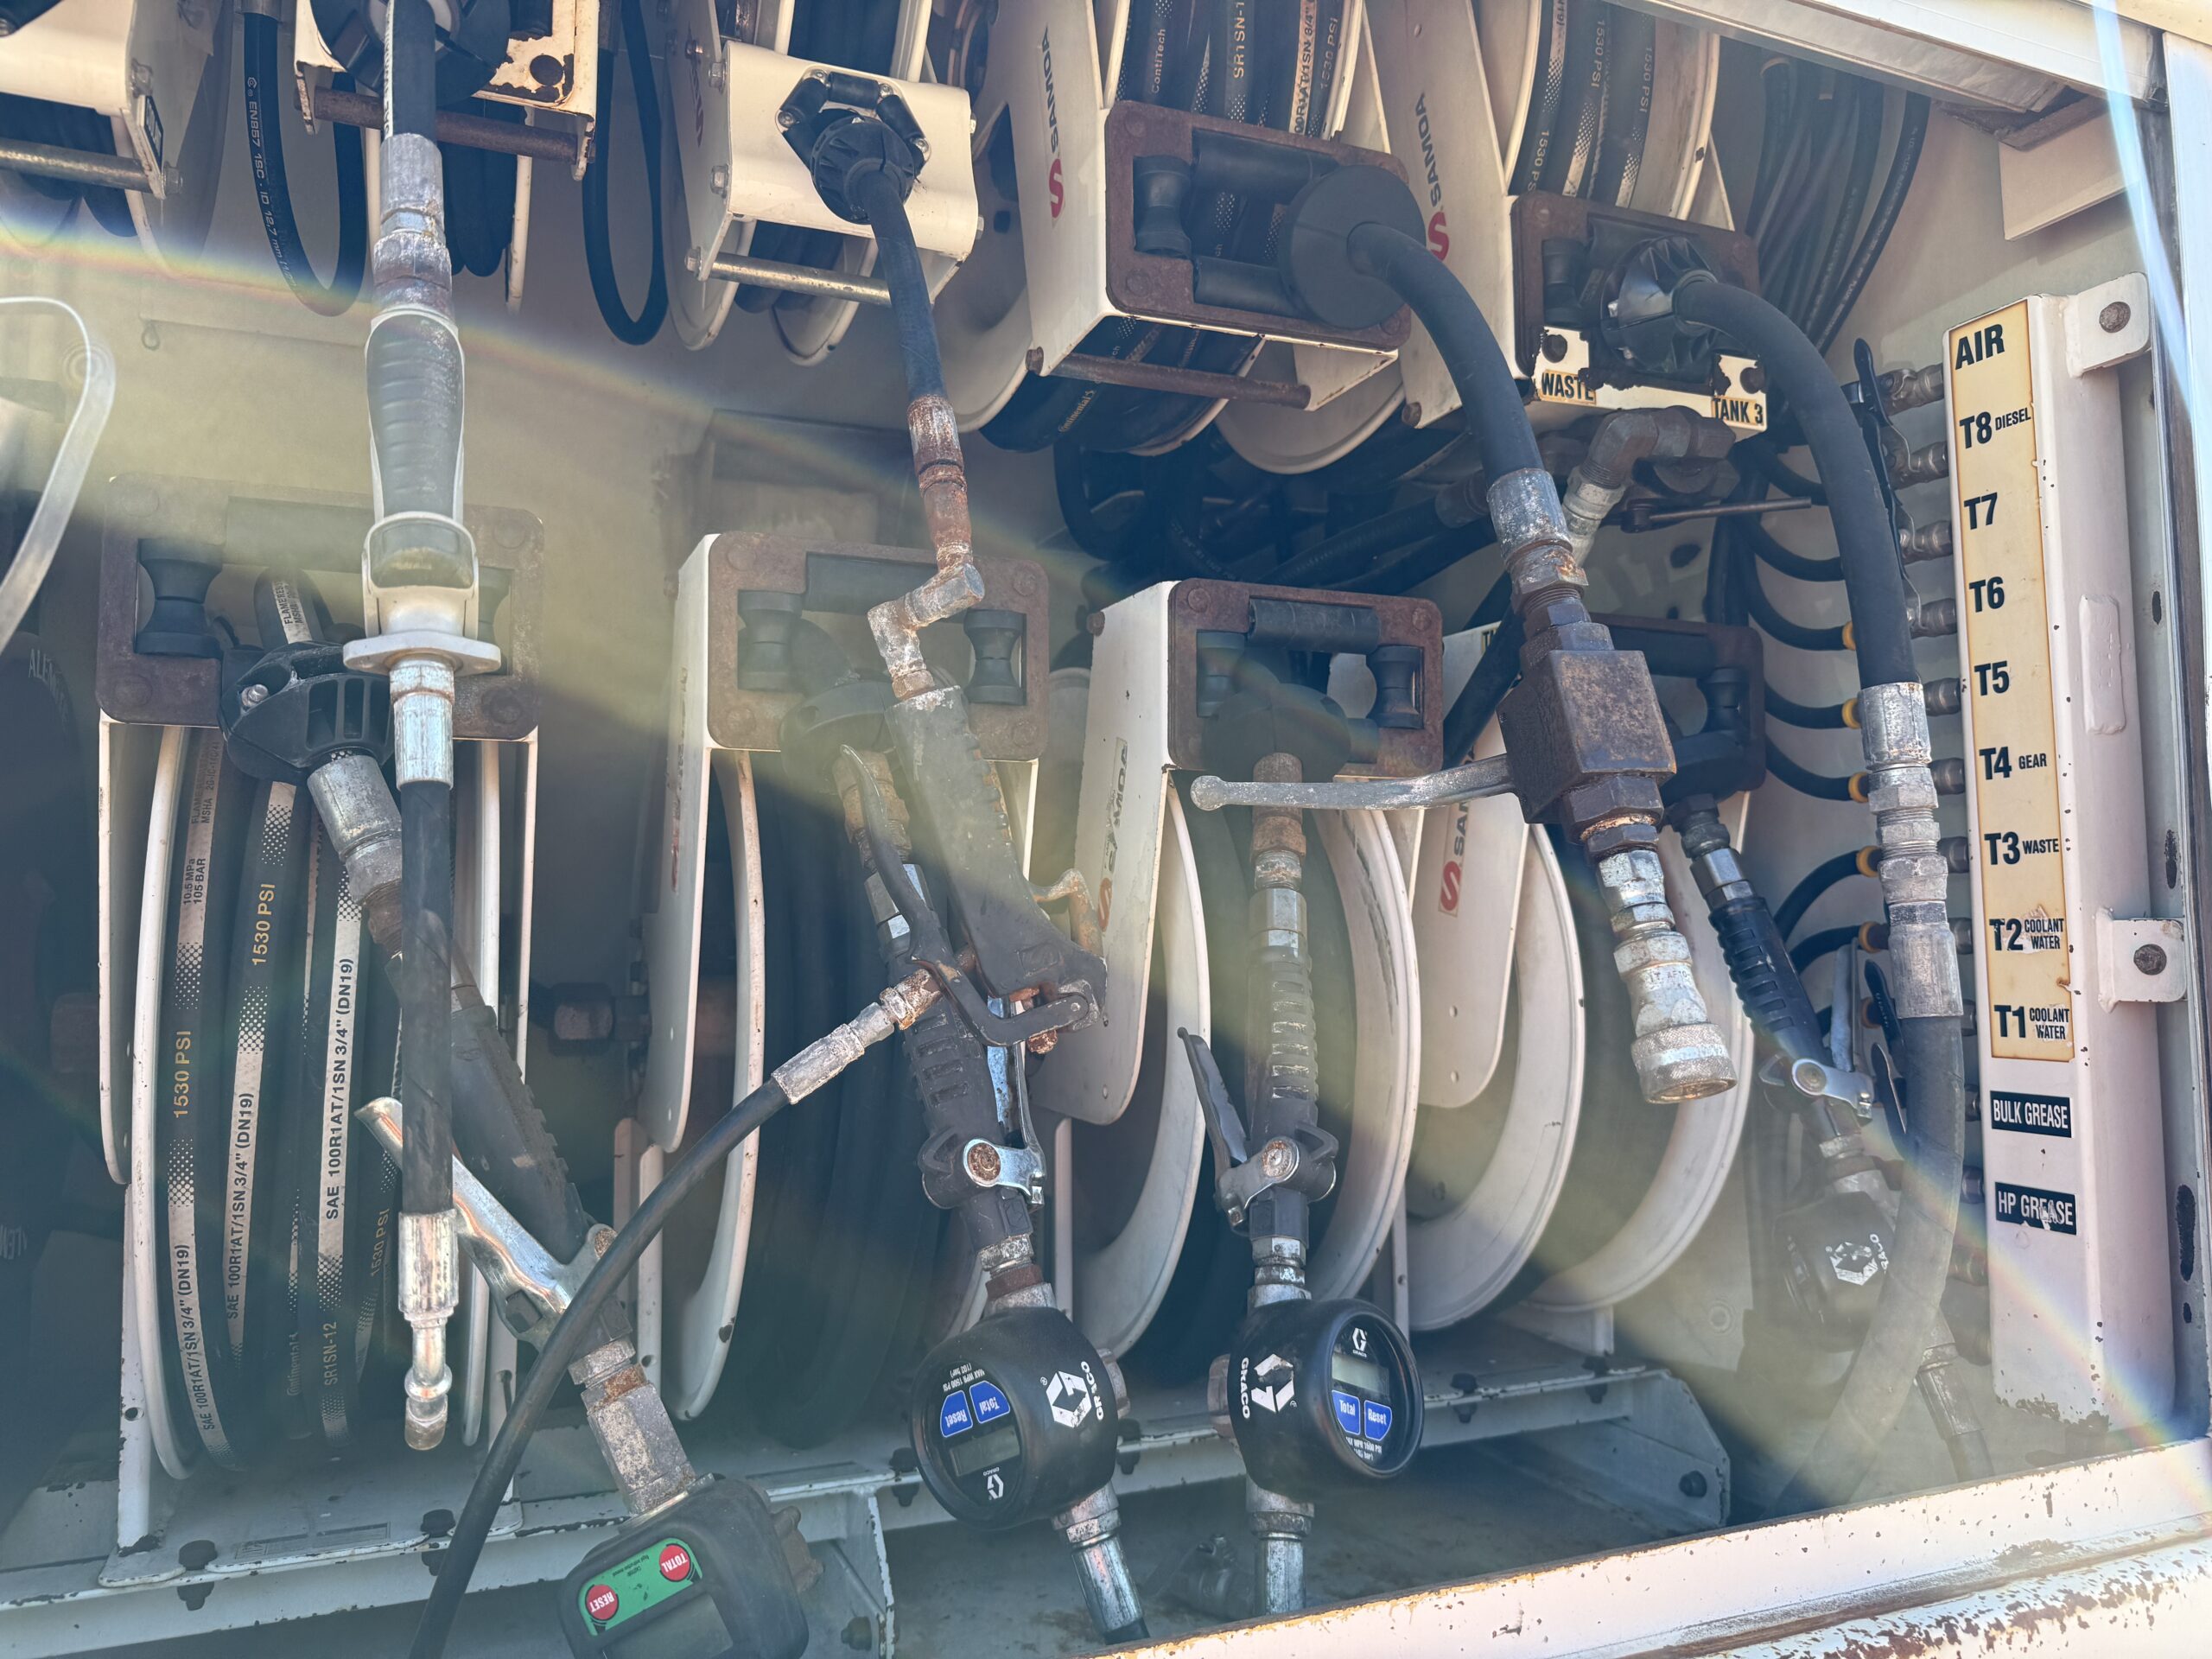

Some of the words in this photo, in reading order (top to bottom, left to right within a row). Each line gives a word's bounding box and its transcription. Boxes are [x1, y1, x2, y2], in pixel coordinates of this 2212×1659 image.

[1321, 52, 1334, 90] 1530
[1329, 17, 1339, 47] PSI
[1595, 20, 1605, 56] 1530
[1151, 29, 1166, 93] ContiTech
[1591, 60, 1603, 87] PSI
[1643, 48, 1652, 81] 1530
[1042, 27, 1058, 154] SAMOA
[1639, 86, 1650, 112] PSI
[1415, 92, 1441, 207] SAMOA
[1534, 130, 1549, 167] 1530
[1955, 324, 2005, 370] AIR
[1541, 372, 1594, 402] WASTE
[1713, 397, 1751, 423] TANK
[1754, 404, 1764, 424] 3
[1960, 411, 1993, 449] T8
[1995, 407, 2031, 431] DIESEL
[1964, 492, 1998, 530] T7
[1968, 576, 2005, 613] T6
[1974, 660, 2010, 696] T5
[1979, 747, 2012, 780] T4
[2018, 753, 2047, 769] GEAR
[200, 798, 213, 823] MSHA
[1984, 831, 2020, 865] T3
[2023, 838, 2059, 854] WASTE
[257, 884, 275, 916] PSI
[251, 920, 270, 966] 1530
[1989, 918, 2023, 951] T2
[2024, 918, 2064, 933] COOLANT
[2031, 935, 2060, 950] WATER
[336, 958, 354, 1015] (DN19)
[334, 1019, 347, 1055] 3/4"
[1993, 1004, 2026, 1039] T1
[2029, 1007, 2069, 1023] COOLANT
[2036, 1024, 2066, 1039] WATER
[175, 1031, 191, 1065] PSI
[174, 1071, 189, 1118] 1530
[235, 1093, 255, 1149] (DN19)
[329, 1059, 346, 1176] 100R1AT/1SN
[1993, 1099, 2022, 1124] BULK
[2024, 1102, 2069, 1129] GREASE
[234, 1152, 248, 1189] 3/4"
[326, 1185, 340, 1220] SAE
[1998, 1191, 2017, 1215] HP
[2020, 1194, 2074, 1226] GREASE
[229, 1190, 246, 1288] 100R1AT/1SN
[175, 1244, 192, 1297] (DN19)
[180, 1299, 194, 1329] 3/4"
[227, 1294, 239, 1319] SAE
[182, 1332, 209, 1409] 100R1AT/1SN
[323, 1321, 338, 1386] SR1SN-12
[203, 1414, 215, 1430] SAE
[944, 1409, 968, 1428] Reset
[979, 1396, 1001, 1415] Total
[1339, 1400, 1356, 1416] Total
[1368, 1408, 1387, 1426] Reset
[661, 1552, 688, 1573] TOTAL
[589, 1592, 615, 1613] RESET
